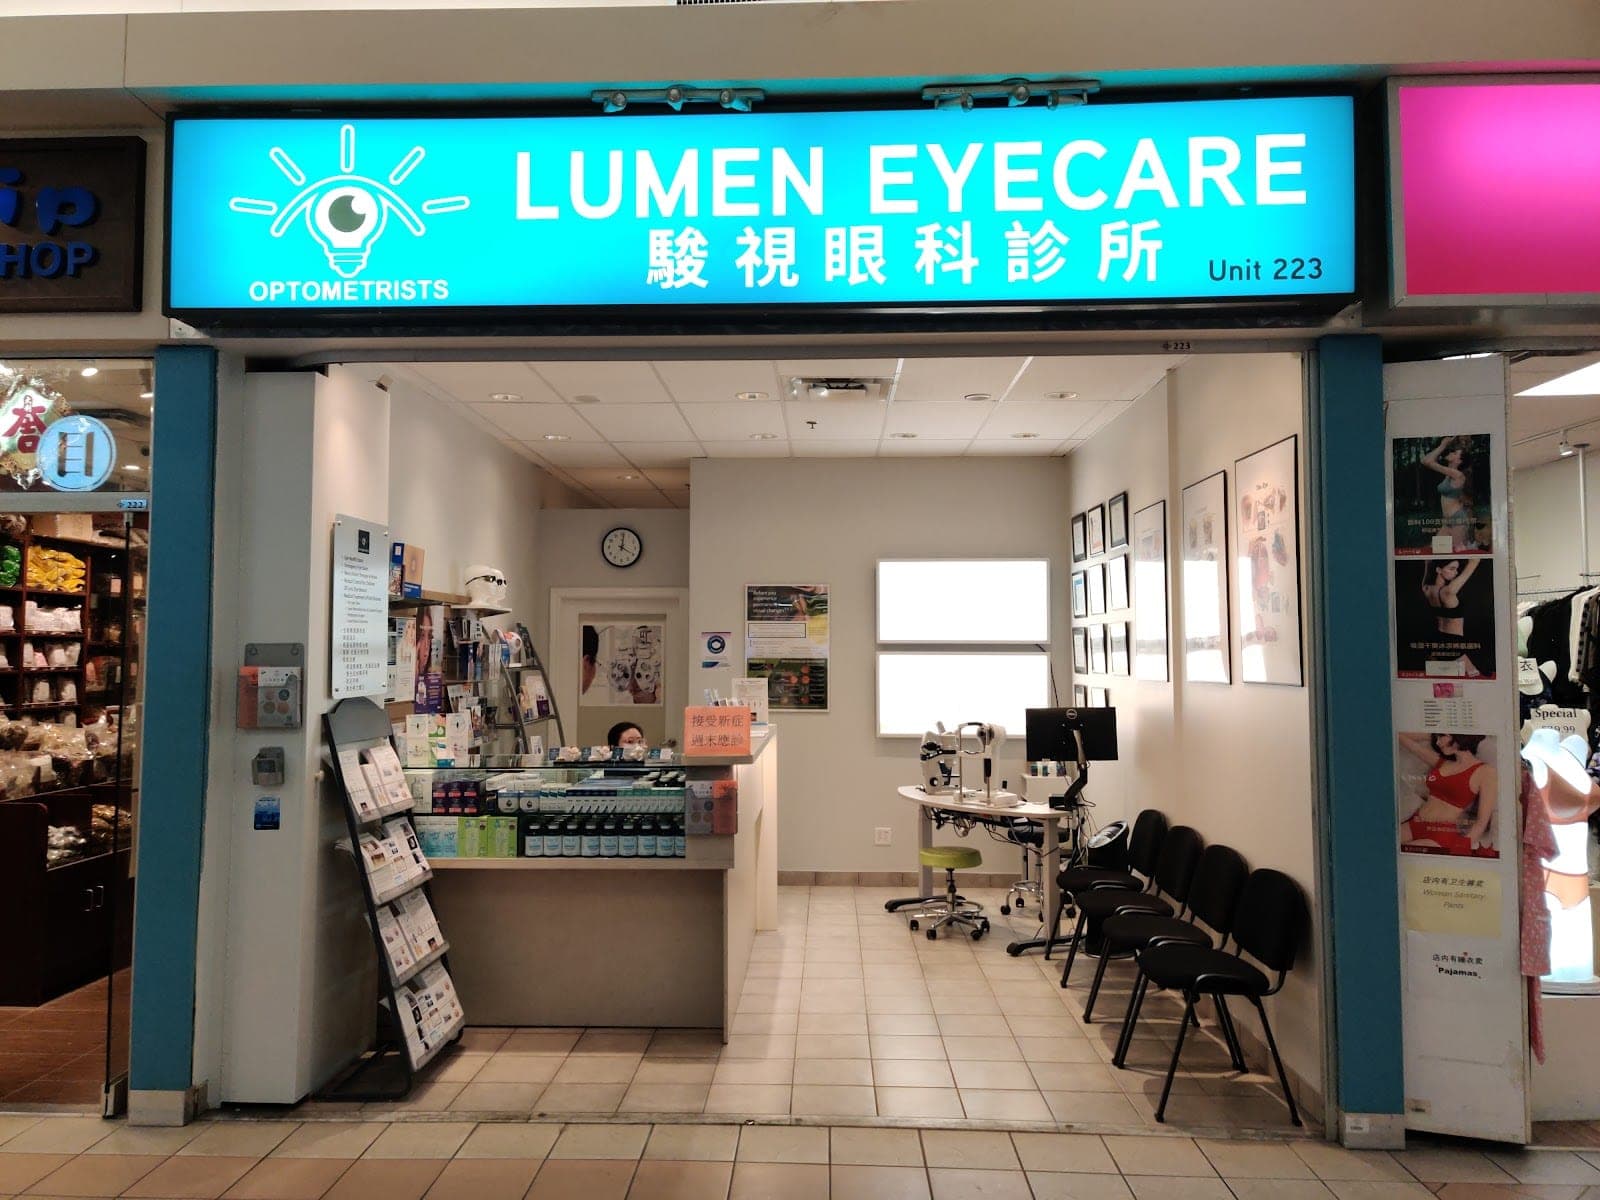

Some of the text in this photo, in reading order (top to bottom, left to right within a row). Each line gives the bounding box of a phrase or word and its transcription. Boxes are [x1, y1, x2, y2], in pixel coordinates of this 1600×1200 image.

[516, 133, 1307, 220] LUMEN EYECARE
[646, 217, 1164, 289] 駿視眼科診所
[1208, 257, 1323, 282] Unit 223
[249, 279, 449, 302] OPTOMETRISTS
[1173, 342, 1191, 350] 223
[127, 501, 145, 509] 222
[1535, 708, 1577, 720] Special
[1438, 967, 1478, 977] Pajamas
